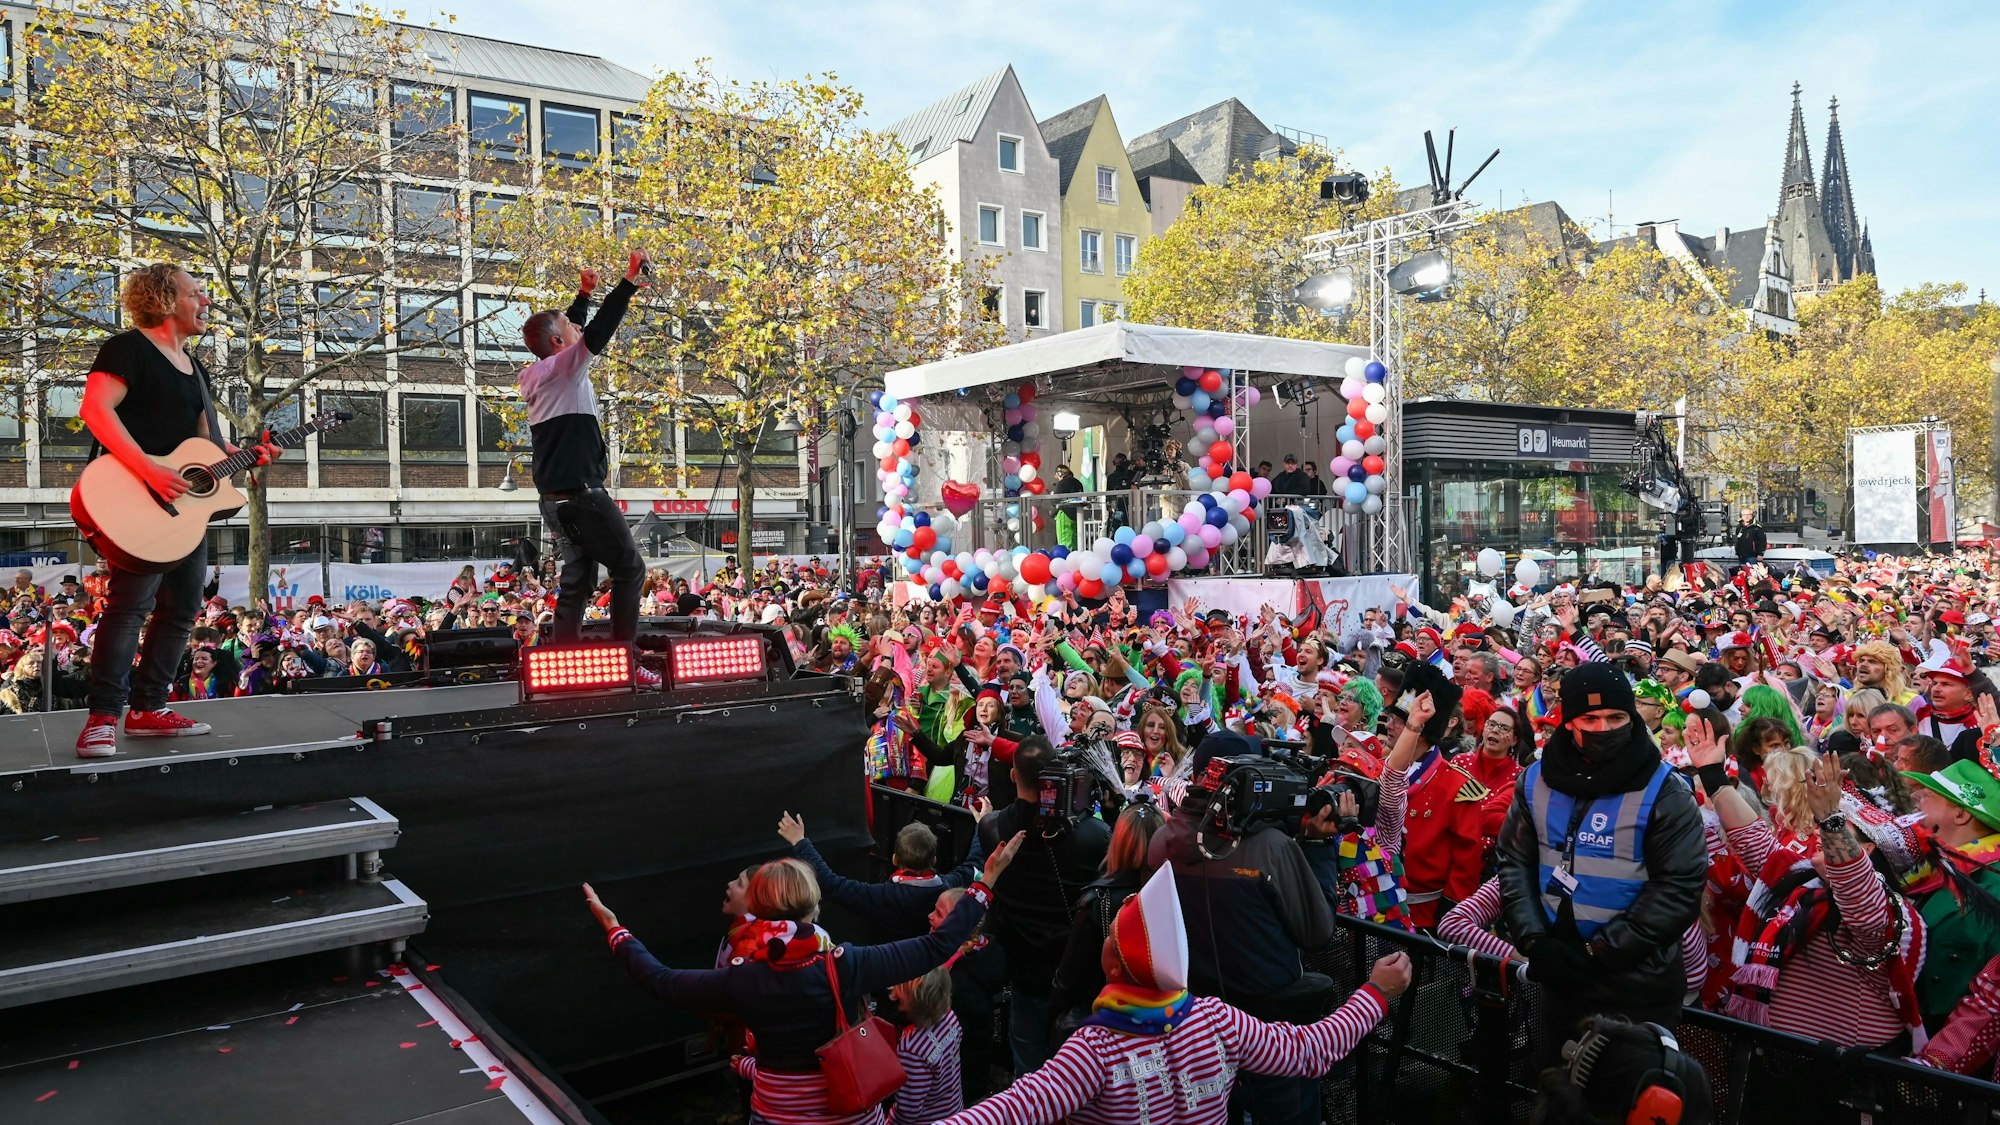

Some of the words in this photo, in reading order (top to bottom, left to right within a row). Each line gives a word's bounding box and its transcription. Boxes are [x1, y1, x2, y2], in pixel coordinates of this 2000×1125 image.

[1551, 435, 1587, 449] Heumarkt
[1858, 476, 1911, 487] @wdrjeck
[653, 500, 709, 514] KIOSK
[31, 556, 60, 567] WC
[1578, 831, 1614, 846] GRAF
[1113, 1058, 1165, 1081] BAUER
